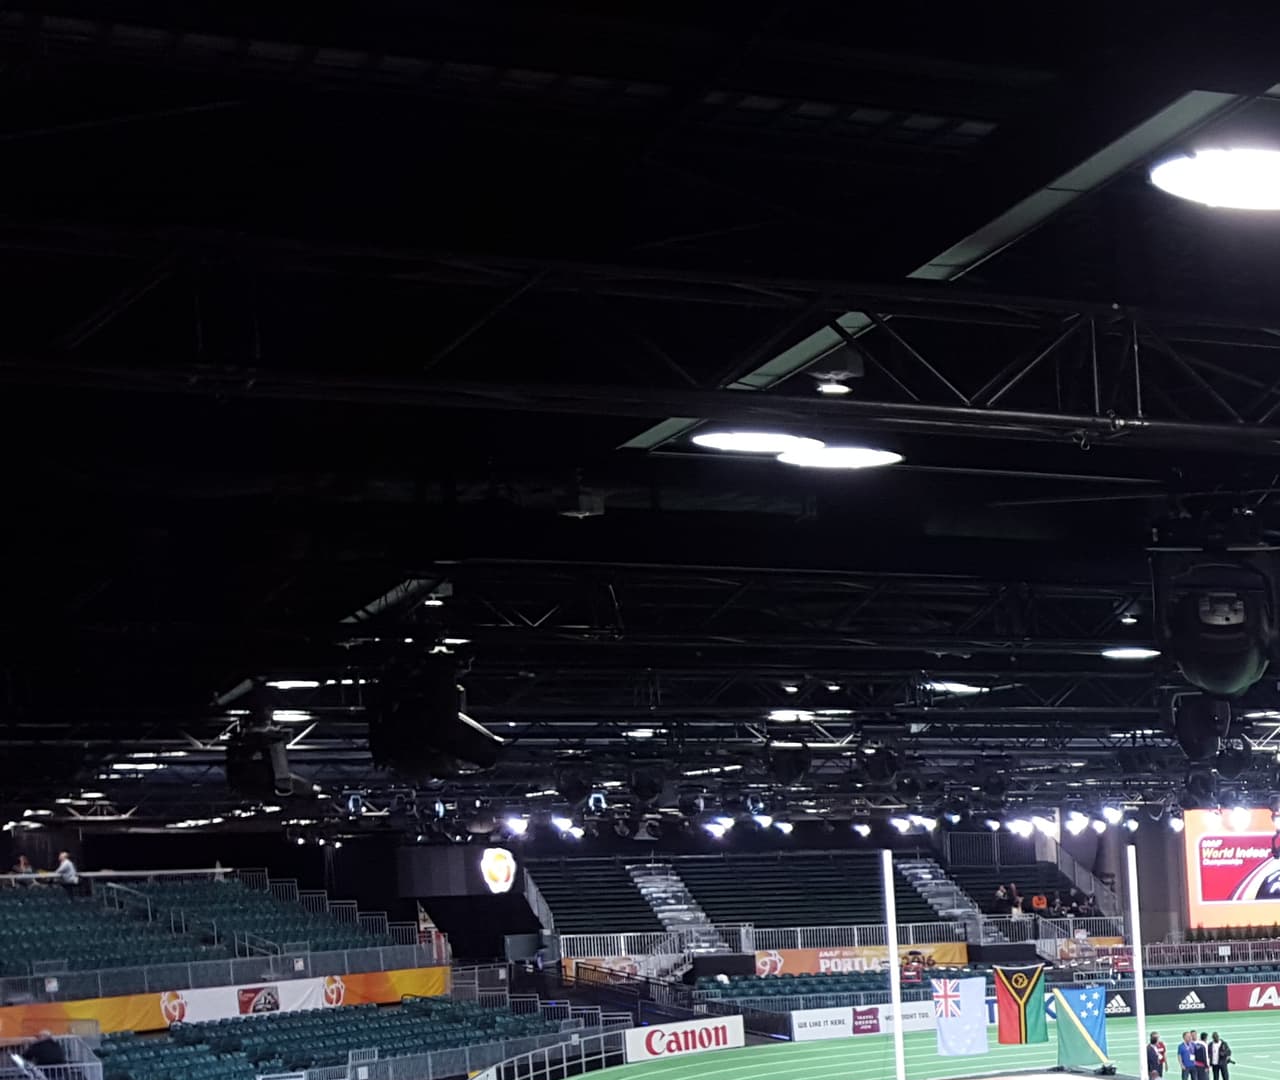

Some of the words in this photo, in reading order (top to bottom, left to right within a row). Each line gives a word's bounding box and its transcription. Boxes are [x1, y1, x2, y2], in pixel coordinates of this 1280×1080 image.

[1202, 849, 1234, 859] World
[1179, 1002, 1206, 1011] adidas
[644, 1024, 728, 1056] Canon
